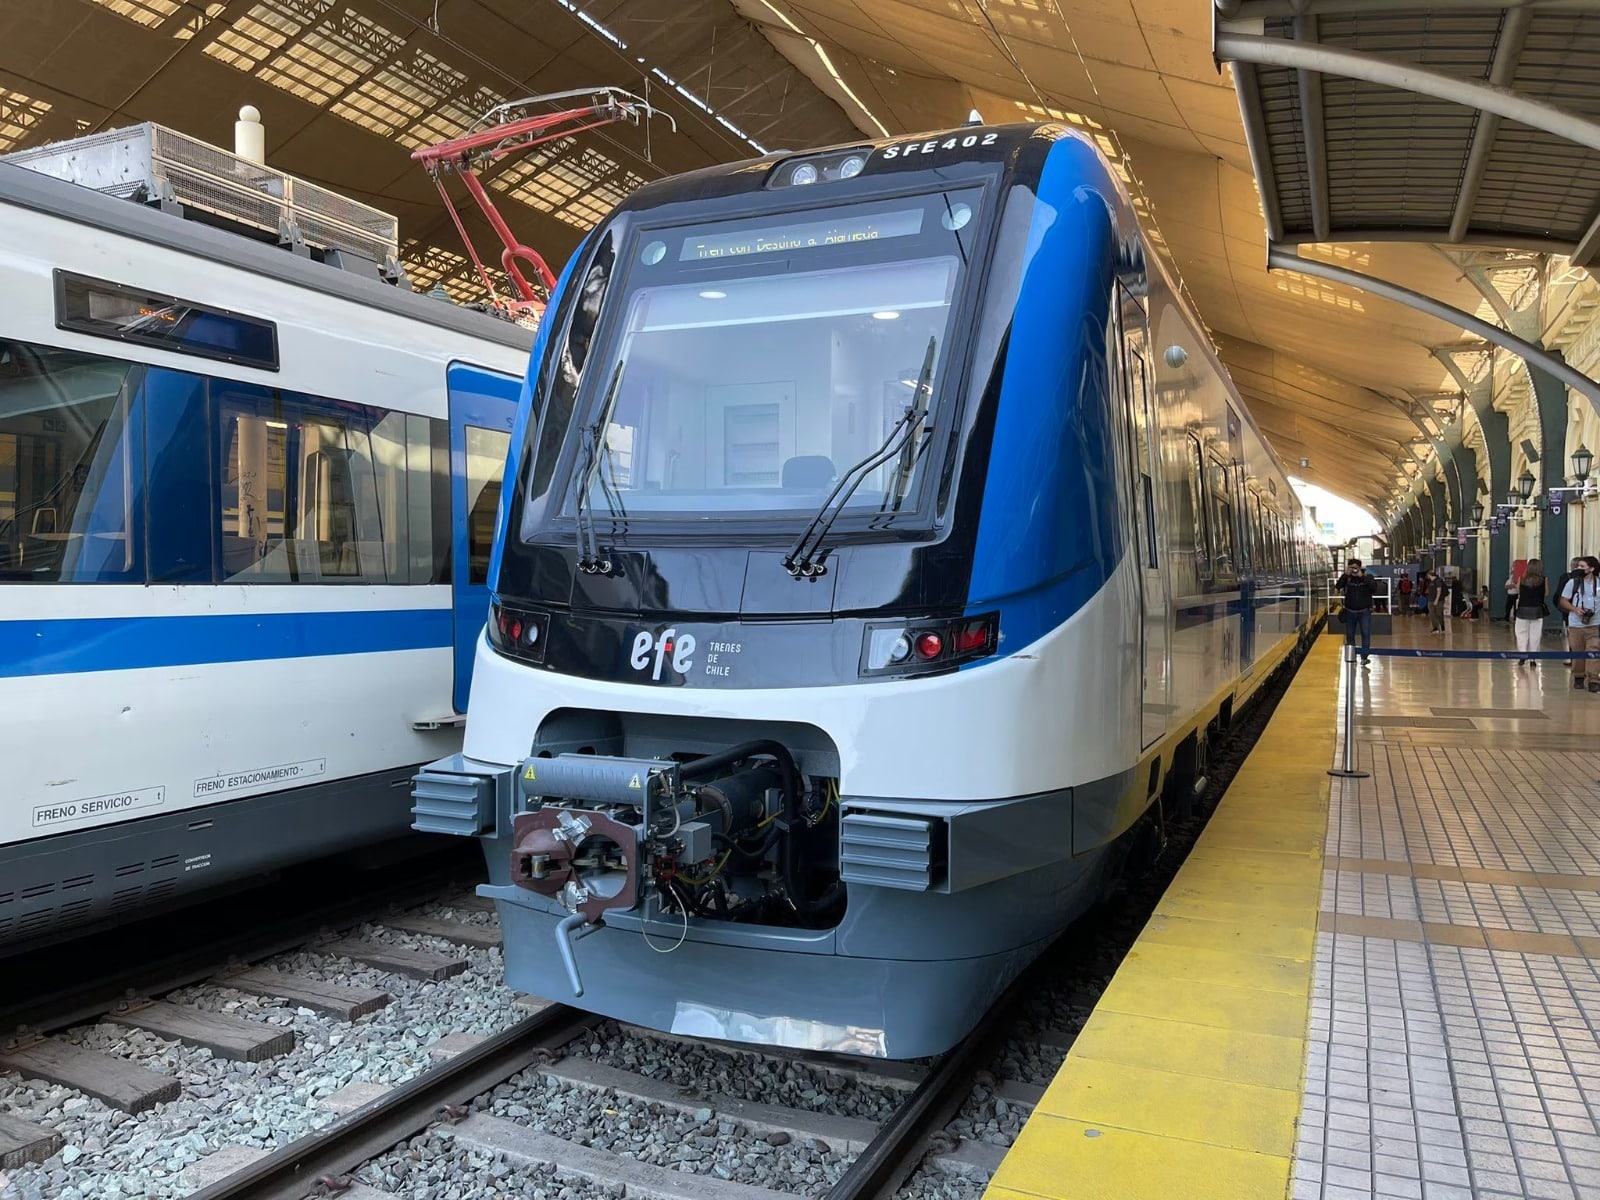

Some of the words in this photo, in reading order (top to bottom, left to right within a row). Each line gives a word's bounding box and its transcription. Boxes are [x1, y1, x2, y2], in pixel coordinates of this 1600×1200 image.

[883, 133, 998, 159] SFE402
[630, 629, 696, 680] efe
[707, 654, 718, 663] DE
[710, 642, 741, 653] TRENES
[705, 665, 730, 676] CHILE
[196, 779, 225, 793] FRENO
[228, 766, 298, 787] ESTACIONAMIENTO
[37, 805, 76, 822] FRENO
[81, 795, 132, 814] SERVICIO
